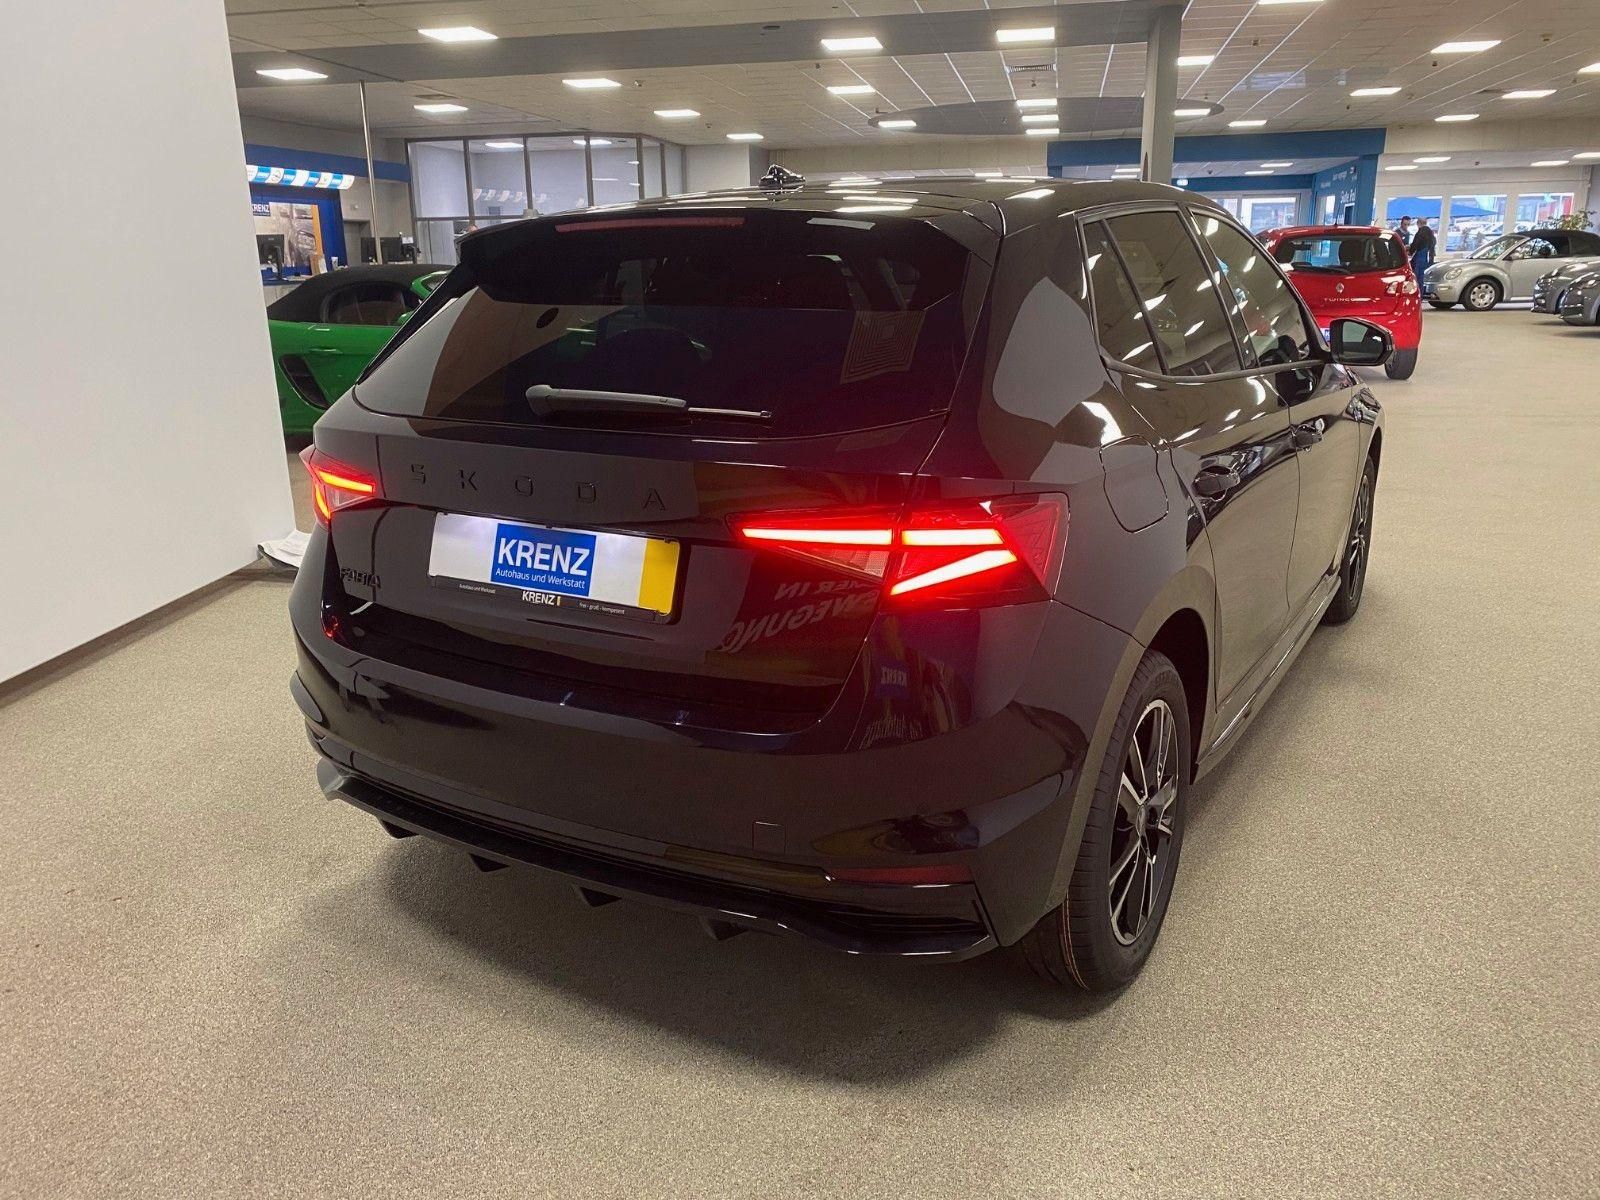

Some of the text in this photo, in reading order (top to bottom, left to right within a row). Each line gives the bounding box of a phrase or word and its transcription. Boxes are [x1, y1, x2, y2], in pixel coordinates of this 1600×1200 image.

[497, 537, 590, 577] KRENZ
[495, 567, 586, 589] Autohaus und Werkstatt
[522, 590, 556, 606] KRENZ
